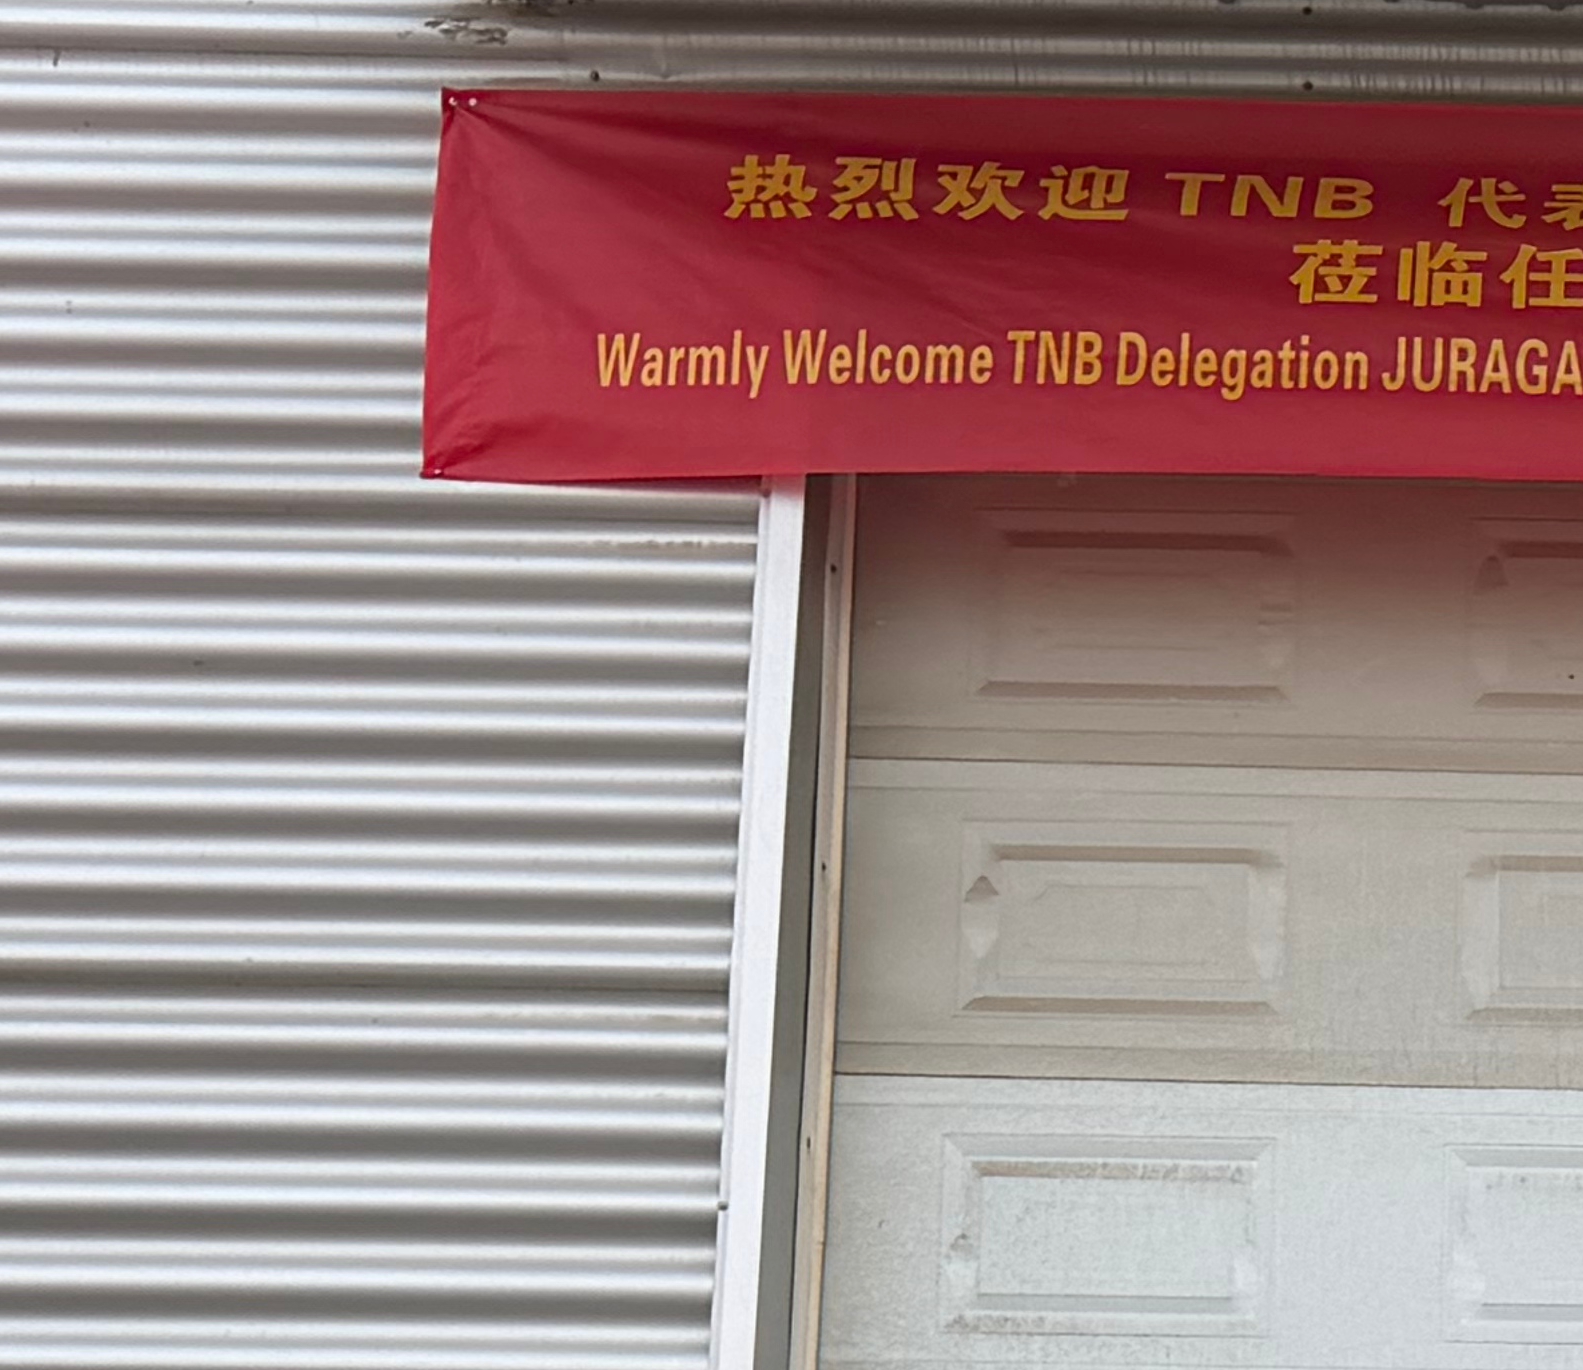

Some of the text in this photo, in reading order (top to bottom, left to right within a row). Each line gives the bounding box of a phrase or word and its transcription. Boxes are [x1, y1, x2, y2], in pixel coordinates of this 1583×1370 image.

[726, 154, 1129, 222] 热烈欢迎
[1171, 173, 1374, 220] TNB
[598, 332, 769, 399] Warmly
[784, 329, 995, 385] Welcome
[1008, 329, 1104, 387] TNB
[1116, 331, 1370, 403] Delegation
